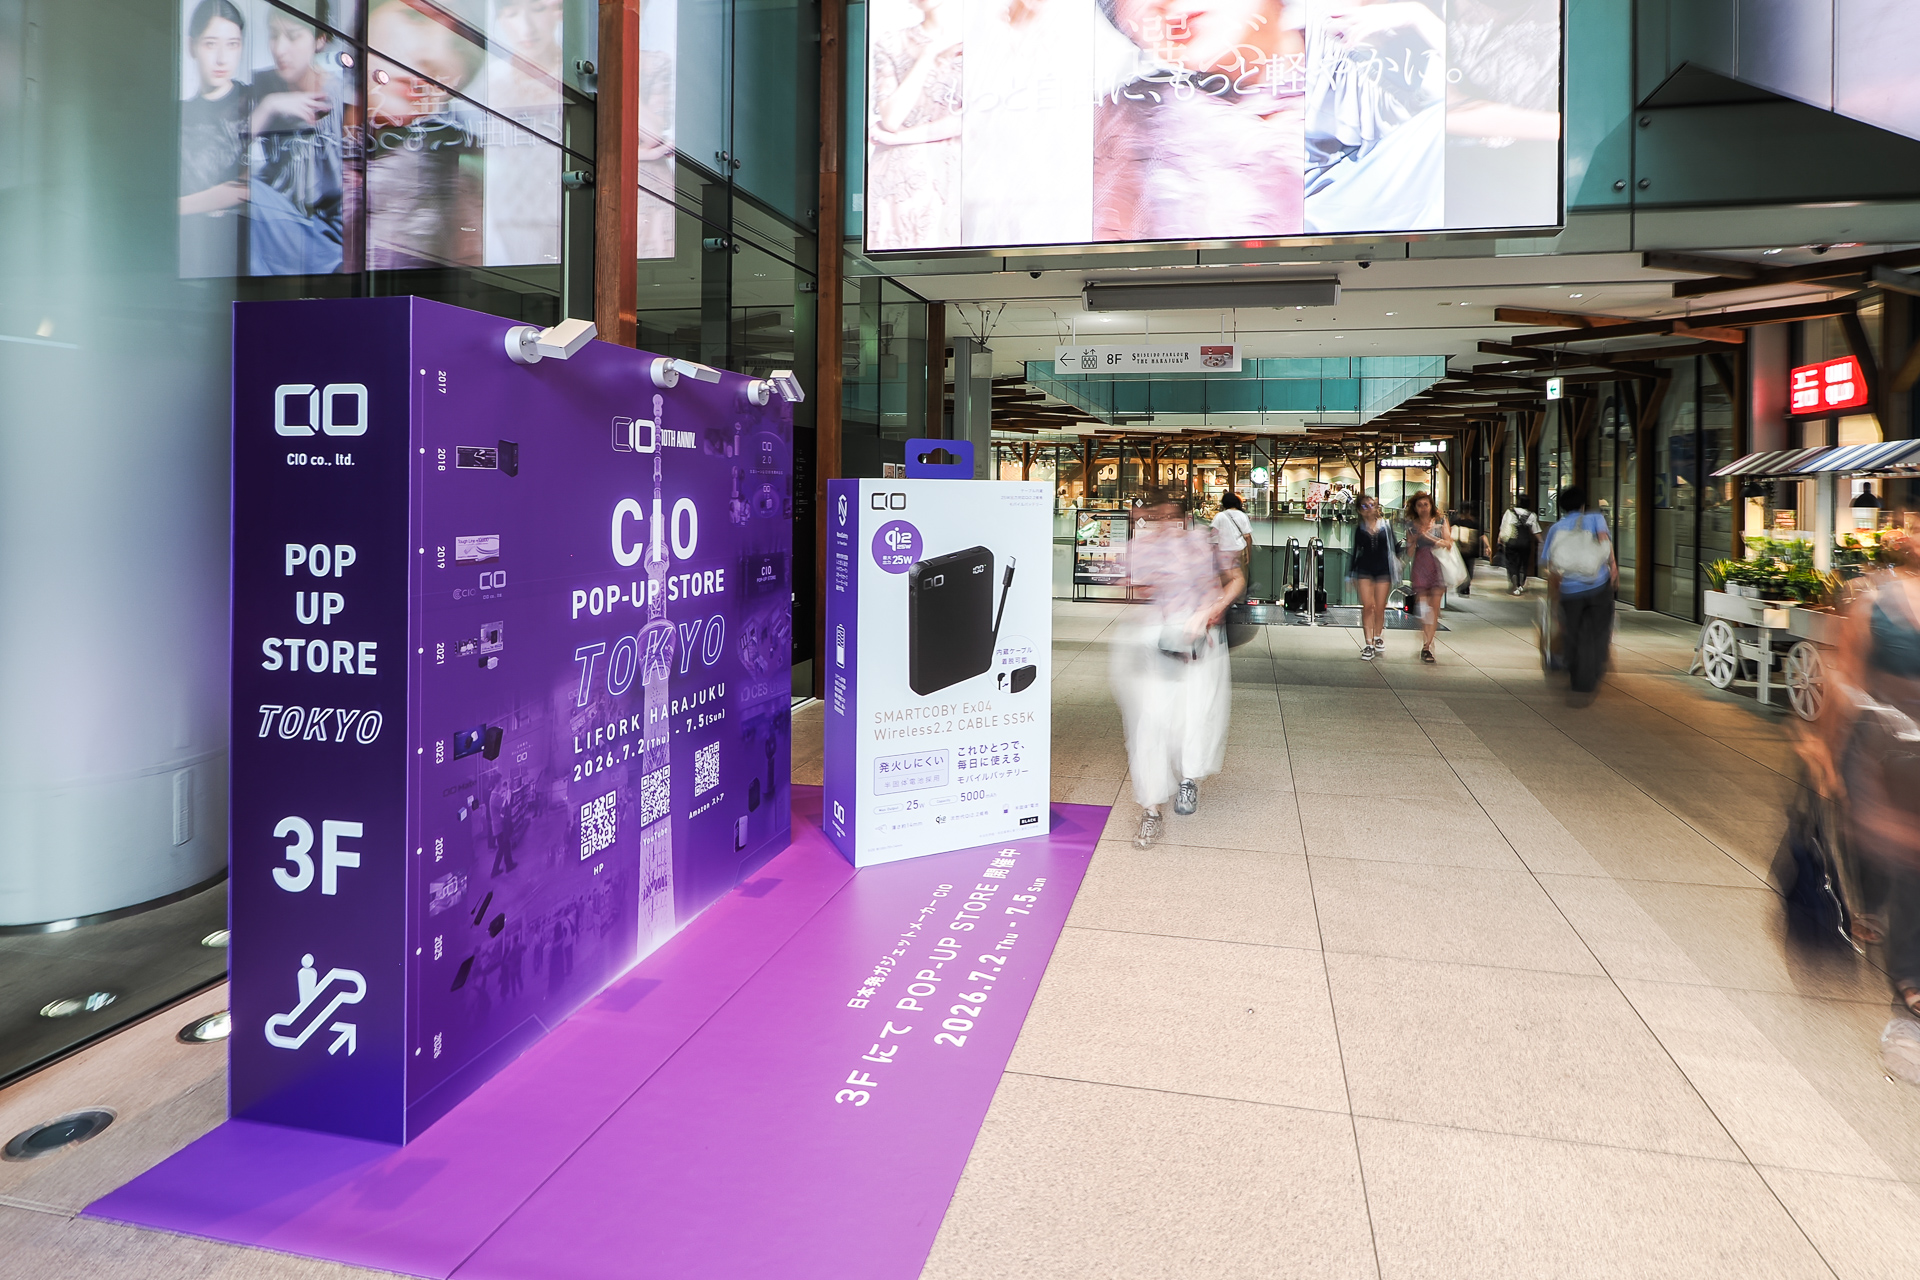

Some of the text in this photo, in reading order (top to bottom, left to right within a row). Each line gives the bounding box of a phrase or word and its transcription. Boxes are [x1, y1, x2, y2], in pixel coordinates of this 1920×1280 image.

[1106, 353, 1122, 365] 8F
[437, 370, 447, 395] 2017
[275, 383, 368, 436] CIO
[287, 453, 308, 466] CIO
[335, 453, 355, 466] ltd.
[437, 448, 446, 471] 2018
[1381, 459, 1432, 467] STARBUCKS
[611, 497, 699, 567] CIO
[285, 543, 357, 578] POP
[436, 545, 446, 569] 2019
[892, 554, 913, 565] 25W
[761, 565, 772, 576] CIO
[572, 569, 725, 619] POP-UP STORE
[296, 591, 345, 625] UP
[261, 637, 378, 675] STORE
[436, 642, 445, 665] 2021
[575, 615, 725, 707] TOKYO
[258, 704, 384, 745] TOKYO
[574, 683, 726, 754] LIFORK HARAJUKU
[874, 700, 993, 724] SMARTCOBY Ex04
[874, 711, 1036, 741] Wireless2.2 CABLE SS5K
[435, 740, 445, 765] 2023
[957, 740, 1026, 757] これひとつで、
[879, 756, 944, 773] 発火しにくい
[957, 753, 1021, 770] 毎日に使える
[957, 769, 1029, 784] モバイルバッテリー
[688, 792, 725, 820] Amazon ストア
[642, 827, 668, 846] YouTube
[271, 815, 364, 896] 3F
[435, 837, 444, 862] 2024
[593, 862, 605, 876] HP
[1027, 877, 1047, 893] Sun
[1005, 894, 1038, 916] 7.5
[434, 935, 443, 961] 2025
[846, 899, 938, 1009] 日本発ガジェットメーカー
[932, 883, 954, 898] CIO
[995, 932, 1019, 951] Thu
[834, 1069, 878, 1107] 3F
[861, 1021, 913, 1063] にて
[895, 936, 962, 1012] POP-UP
[949, 883, 1000, 932] STORE
[983, 848, 1021, 879] 開催中
[933, 954, 1008, 1048] 2026.7.2
